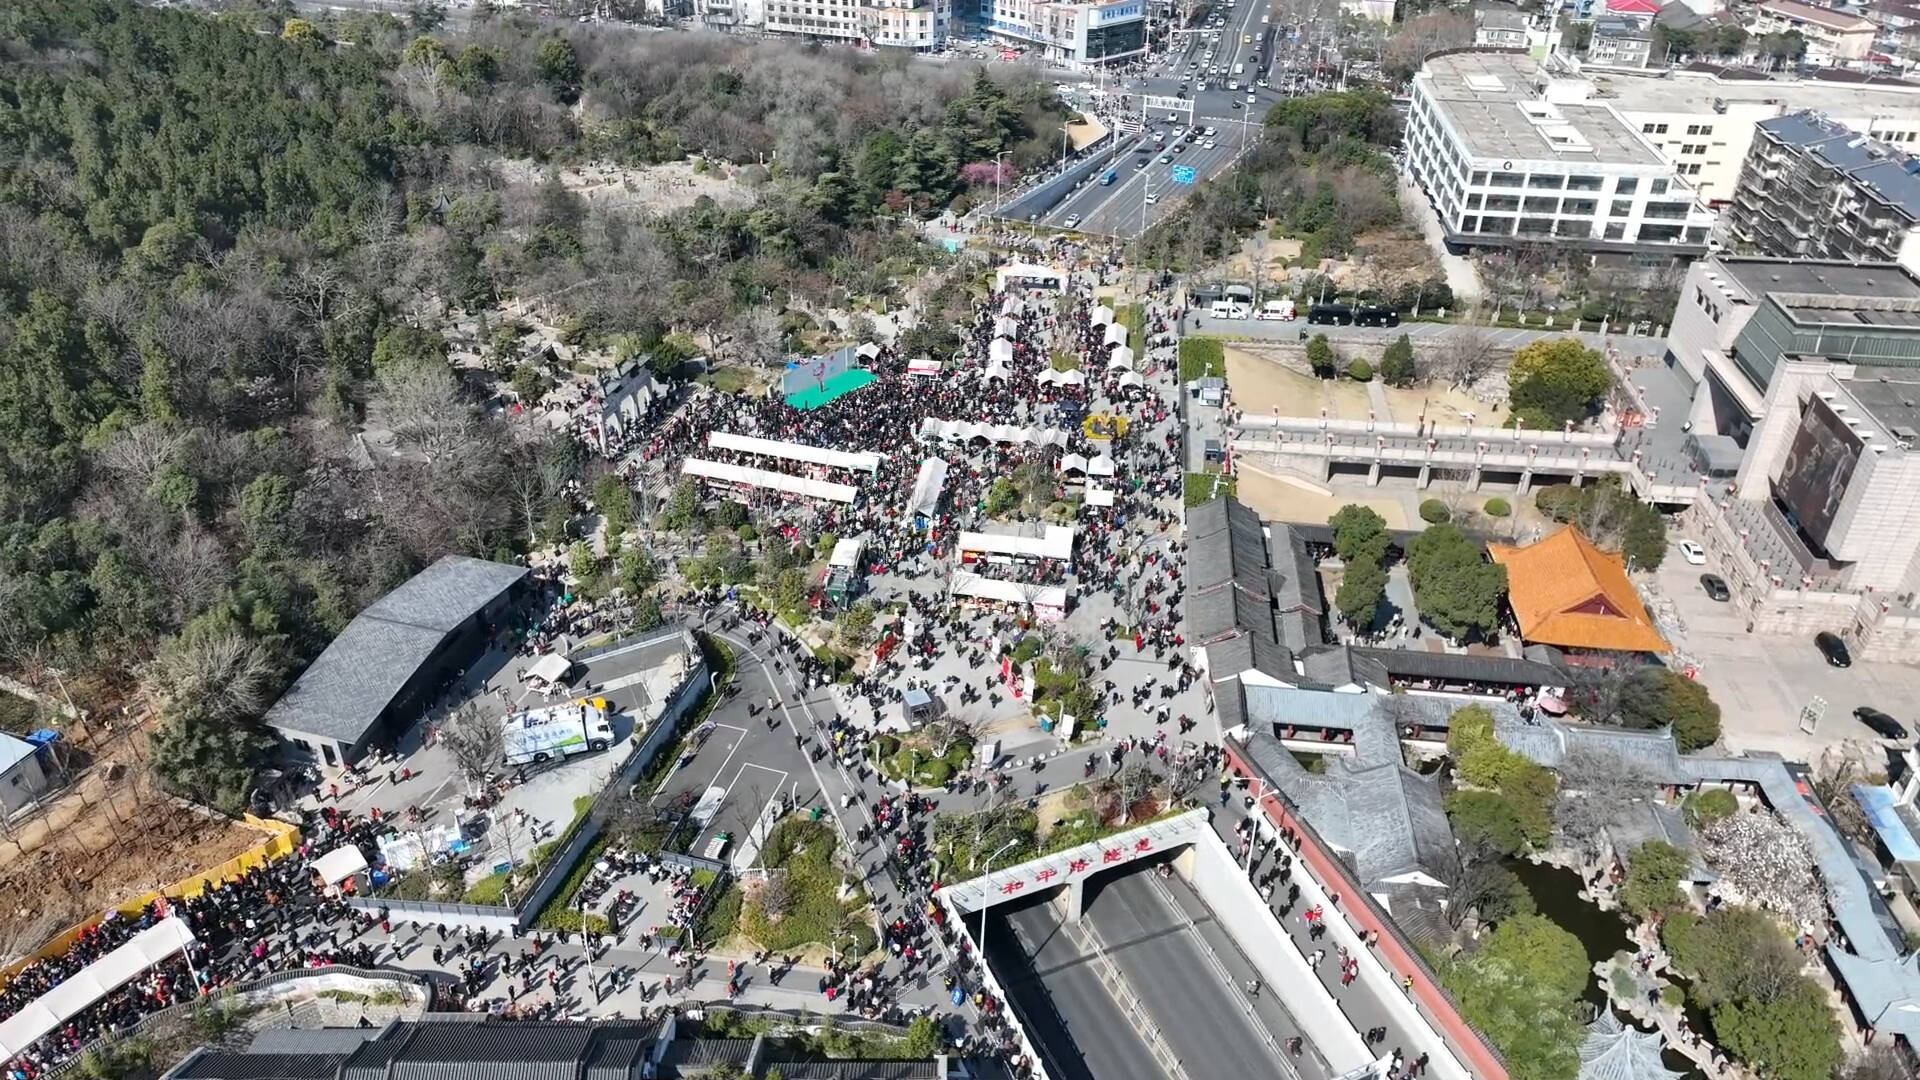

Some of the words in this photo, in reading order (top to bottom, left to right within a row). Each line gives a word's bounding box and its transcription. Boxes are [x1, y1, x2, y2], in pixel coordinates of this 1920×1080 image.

[1002, 838, 1154, 895] 和平路隧道
